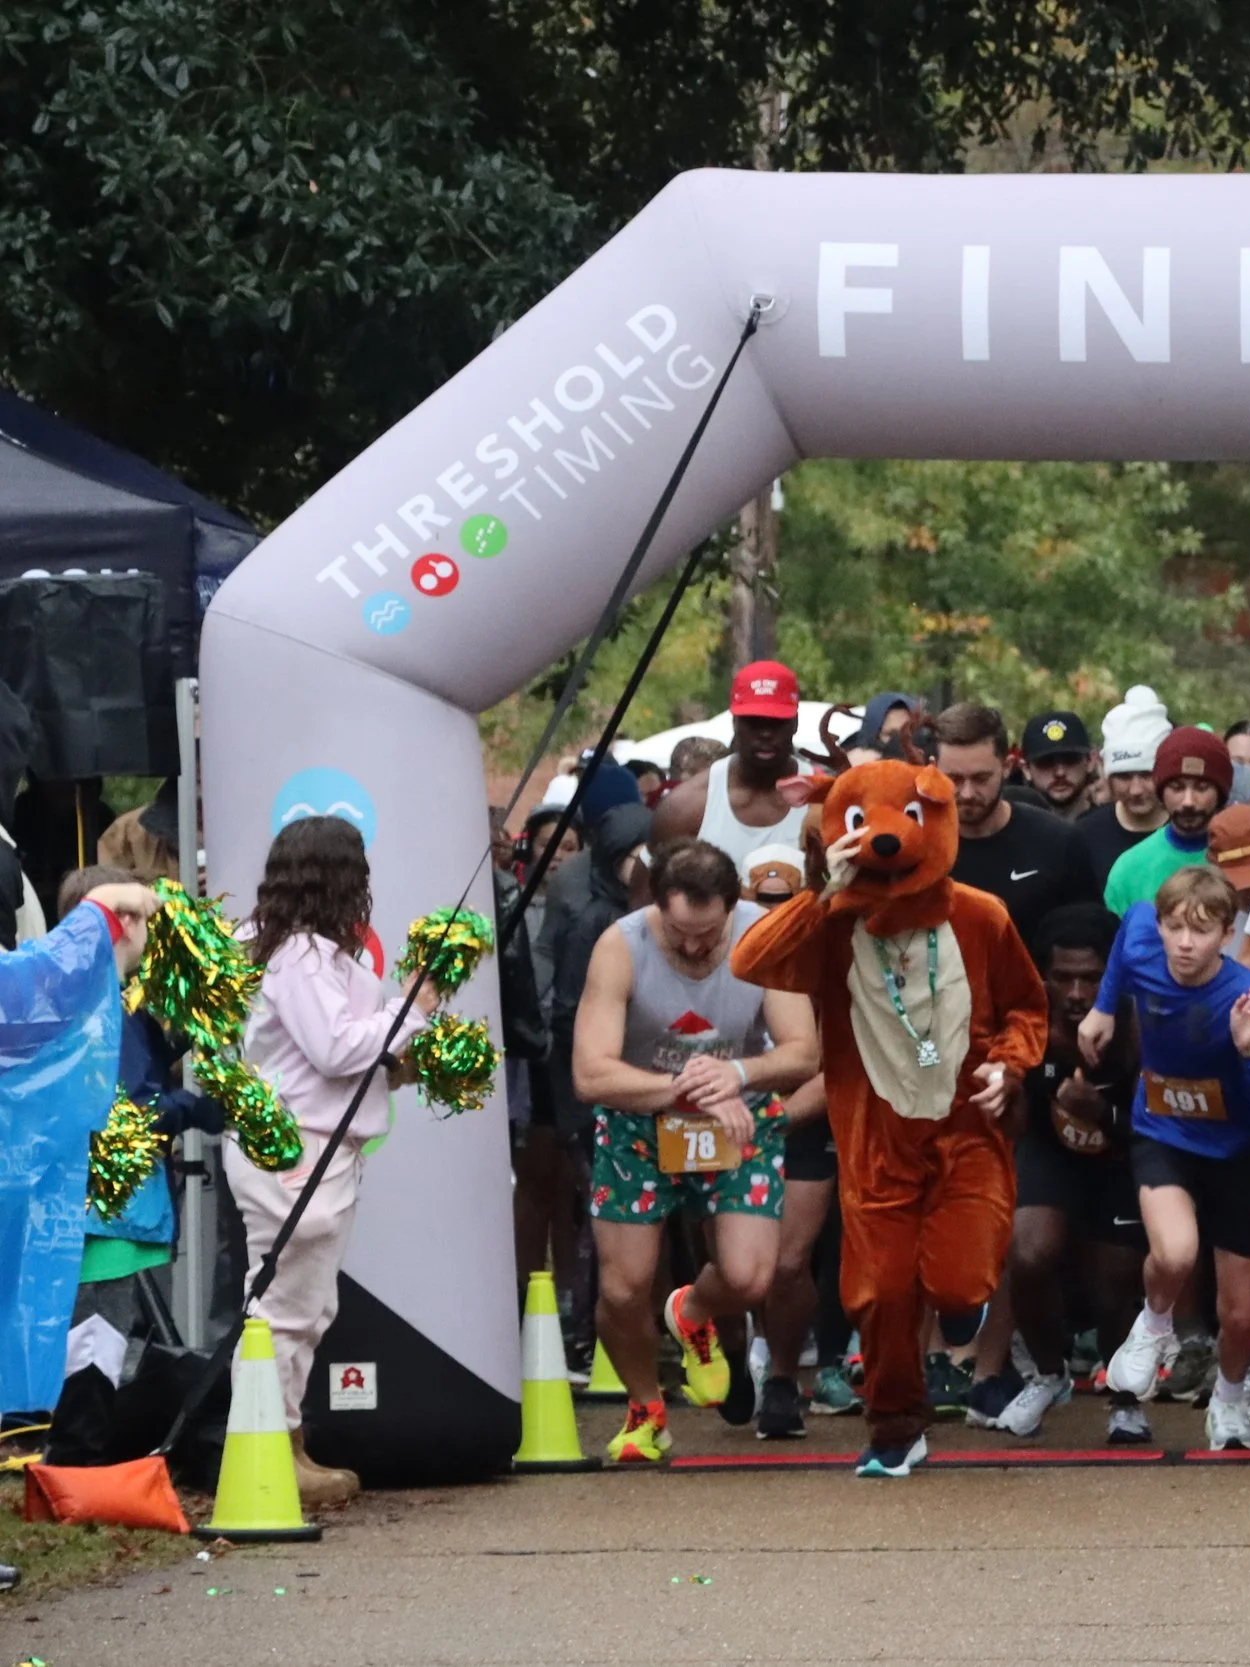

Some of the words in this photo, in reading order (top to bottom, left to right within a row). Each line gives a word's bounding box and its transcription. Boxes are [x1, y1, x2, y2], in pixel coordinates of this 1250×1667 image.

[315, 303, 678, 600] THRESHOLD
[498, 343, 716, 521] TIMING
[683, 1130, 716, 1161] 78
[1162, 1087, 1209, 1113] 491
